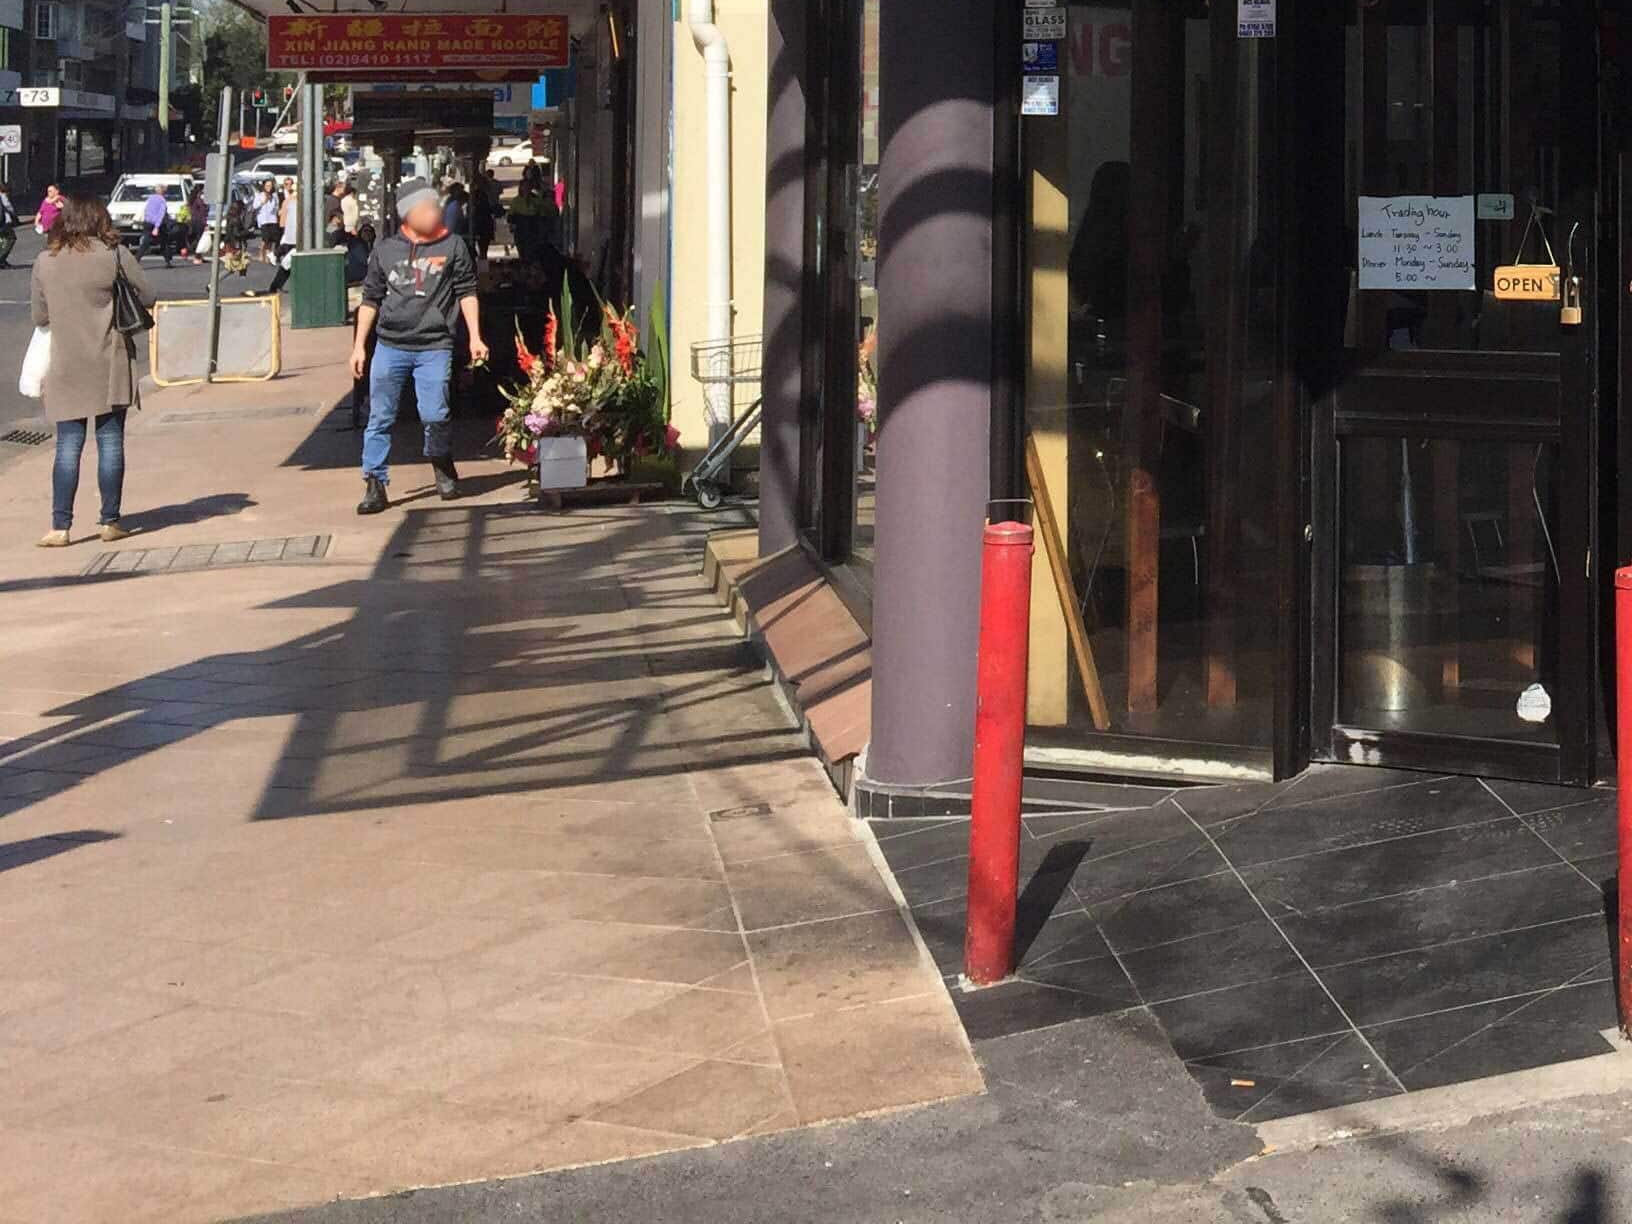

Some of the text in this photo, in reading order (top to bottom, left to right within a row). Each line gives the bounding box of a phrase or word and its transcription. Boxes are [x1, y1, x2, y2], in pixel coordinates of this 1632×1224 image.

[1025, 15, 1065, 26] GLASS
[285, 38, 559, 52] XIN JIANG HAND MADE NOODLE
[1382, 203, 1425, 226] Trading
[1496, 276, 1543, 293] OPEN
